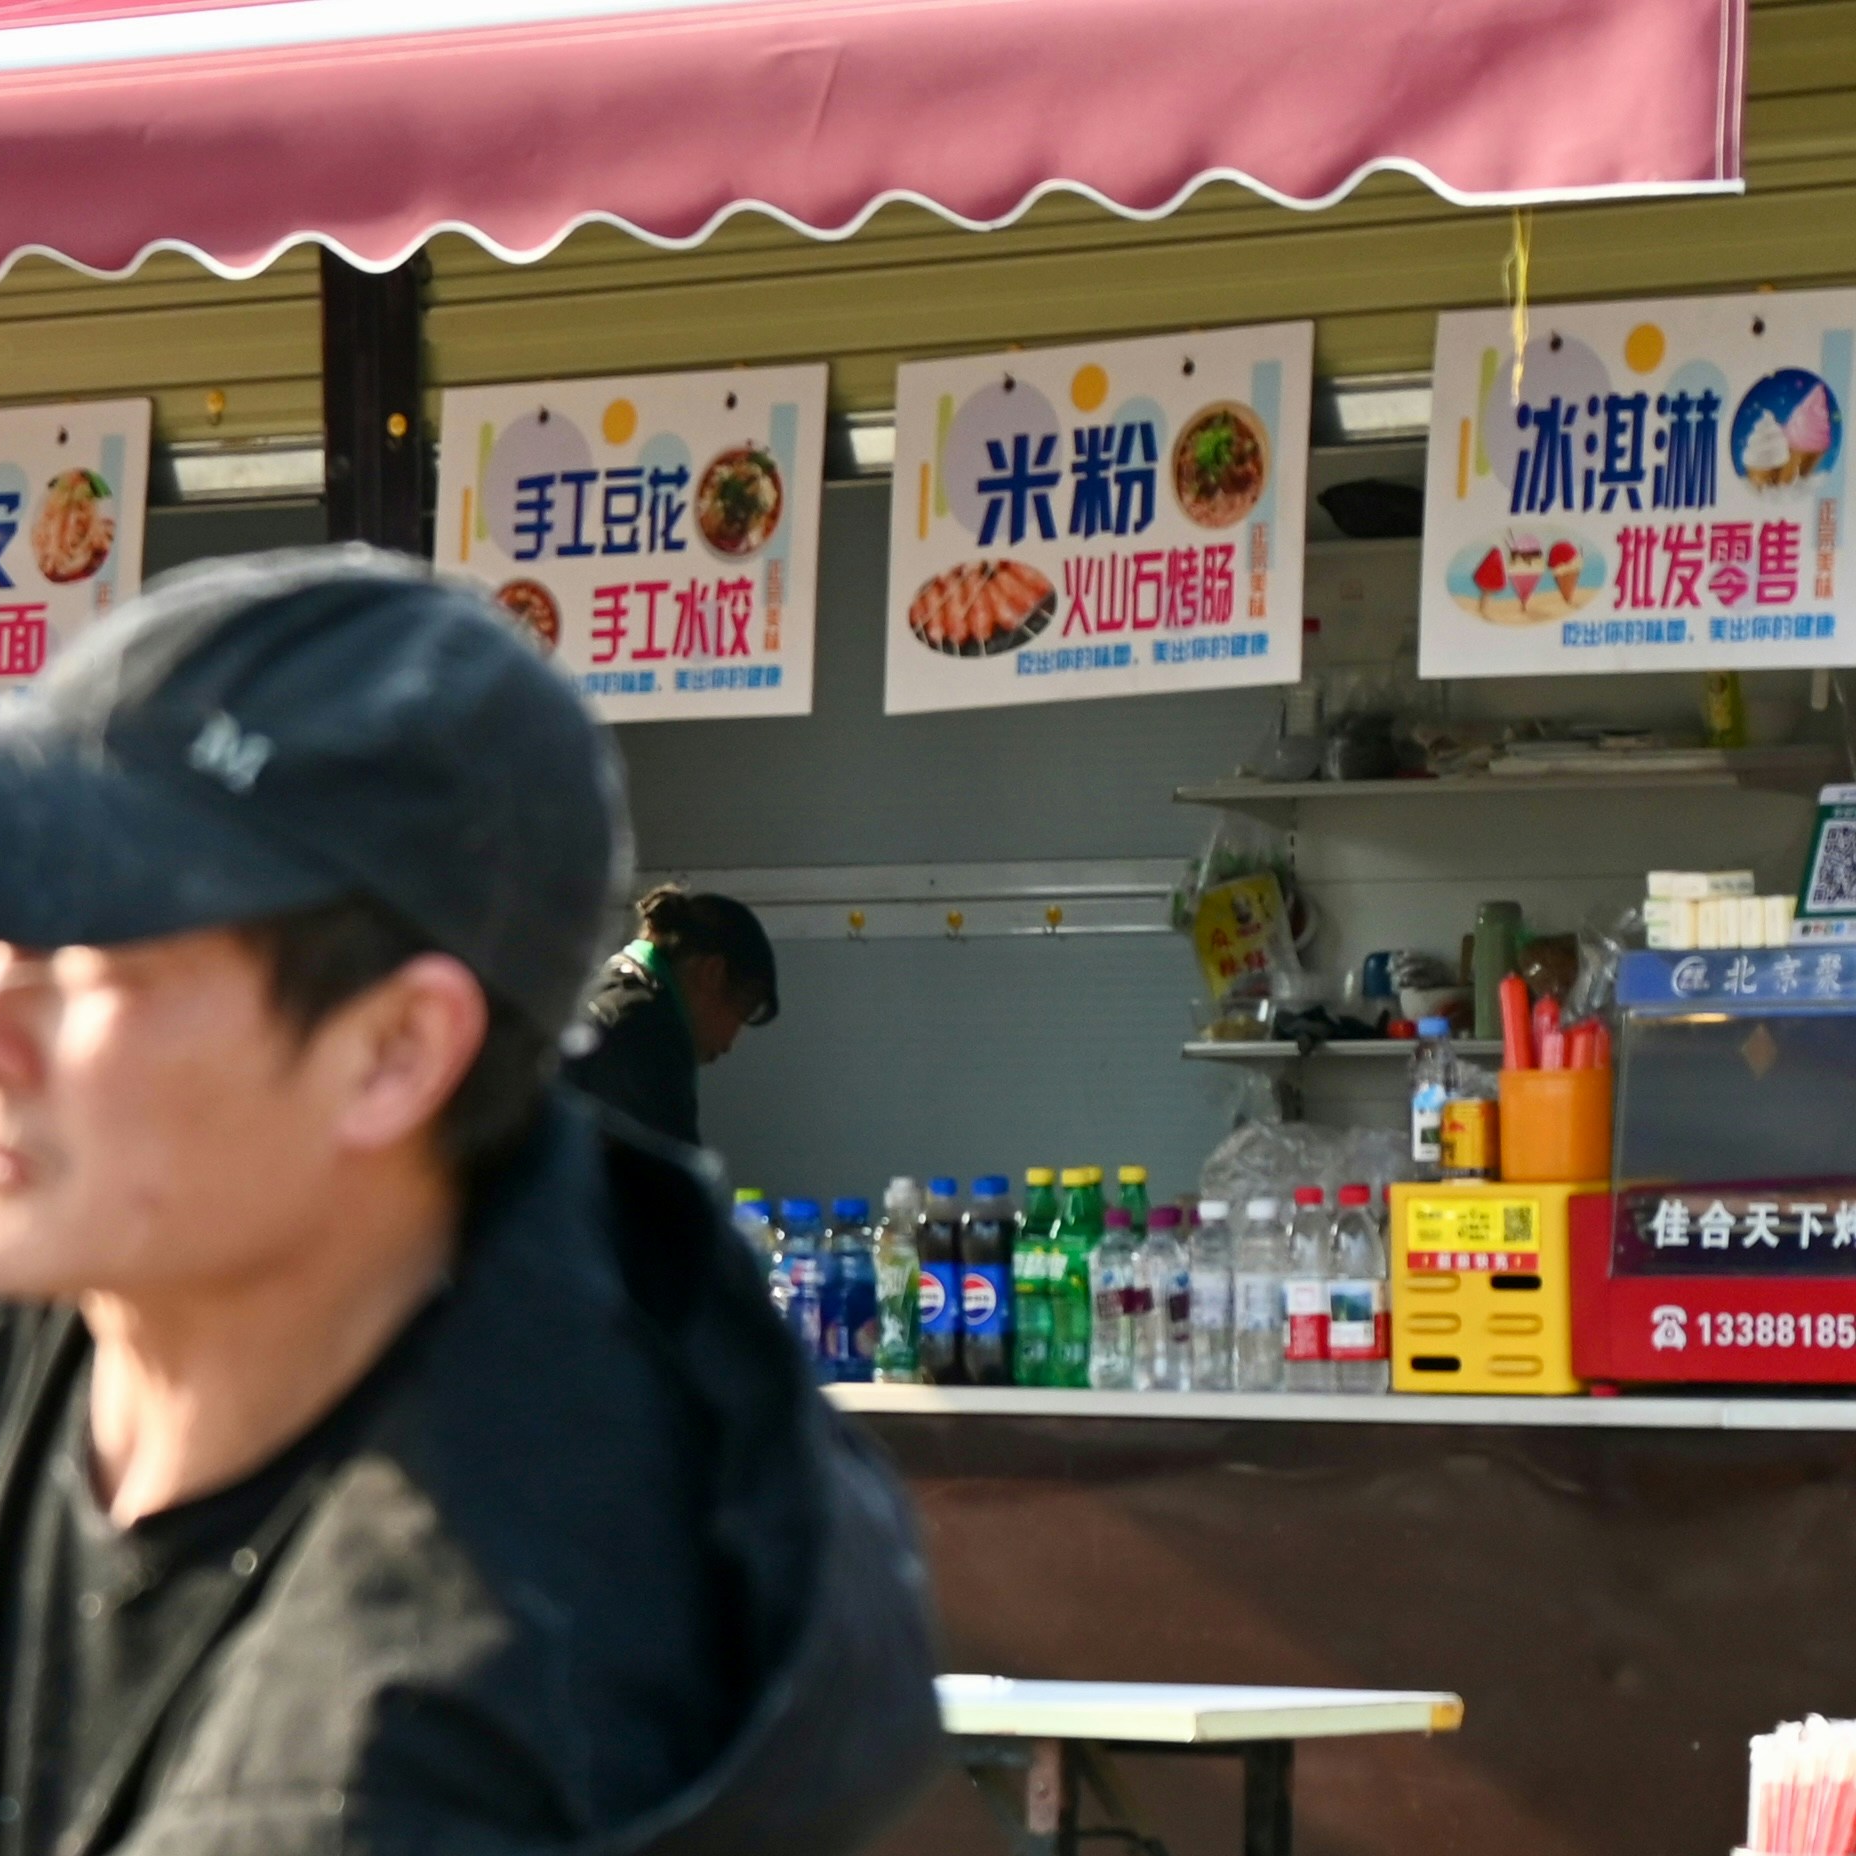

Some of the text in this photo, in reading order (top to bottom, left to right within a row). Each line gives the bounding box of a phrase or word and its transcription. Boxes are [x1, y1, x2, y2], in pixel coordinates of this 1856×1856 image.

[976, 420, 1159, 547] 米粉
[1510, 388, 1722, 518] 冰淇淋
[513, 464, 691, 561] 手工豆花
[1060, 542, 1238, 639] 火山石烤肠
[1613, 517, 1802, 612] 批发零售
[591, 575, 756, 664] 手工水饺
[1697, 1311, 1856, 1349] 13388185
